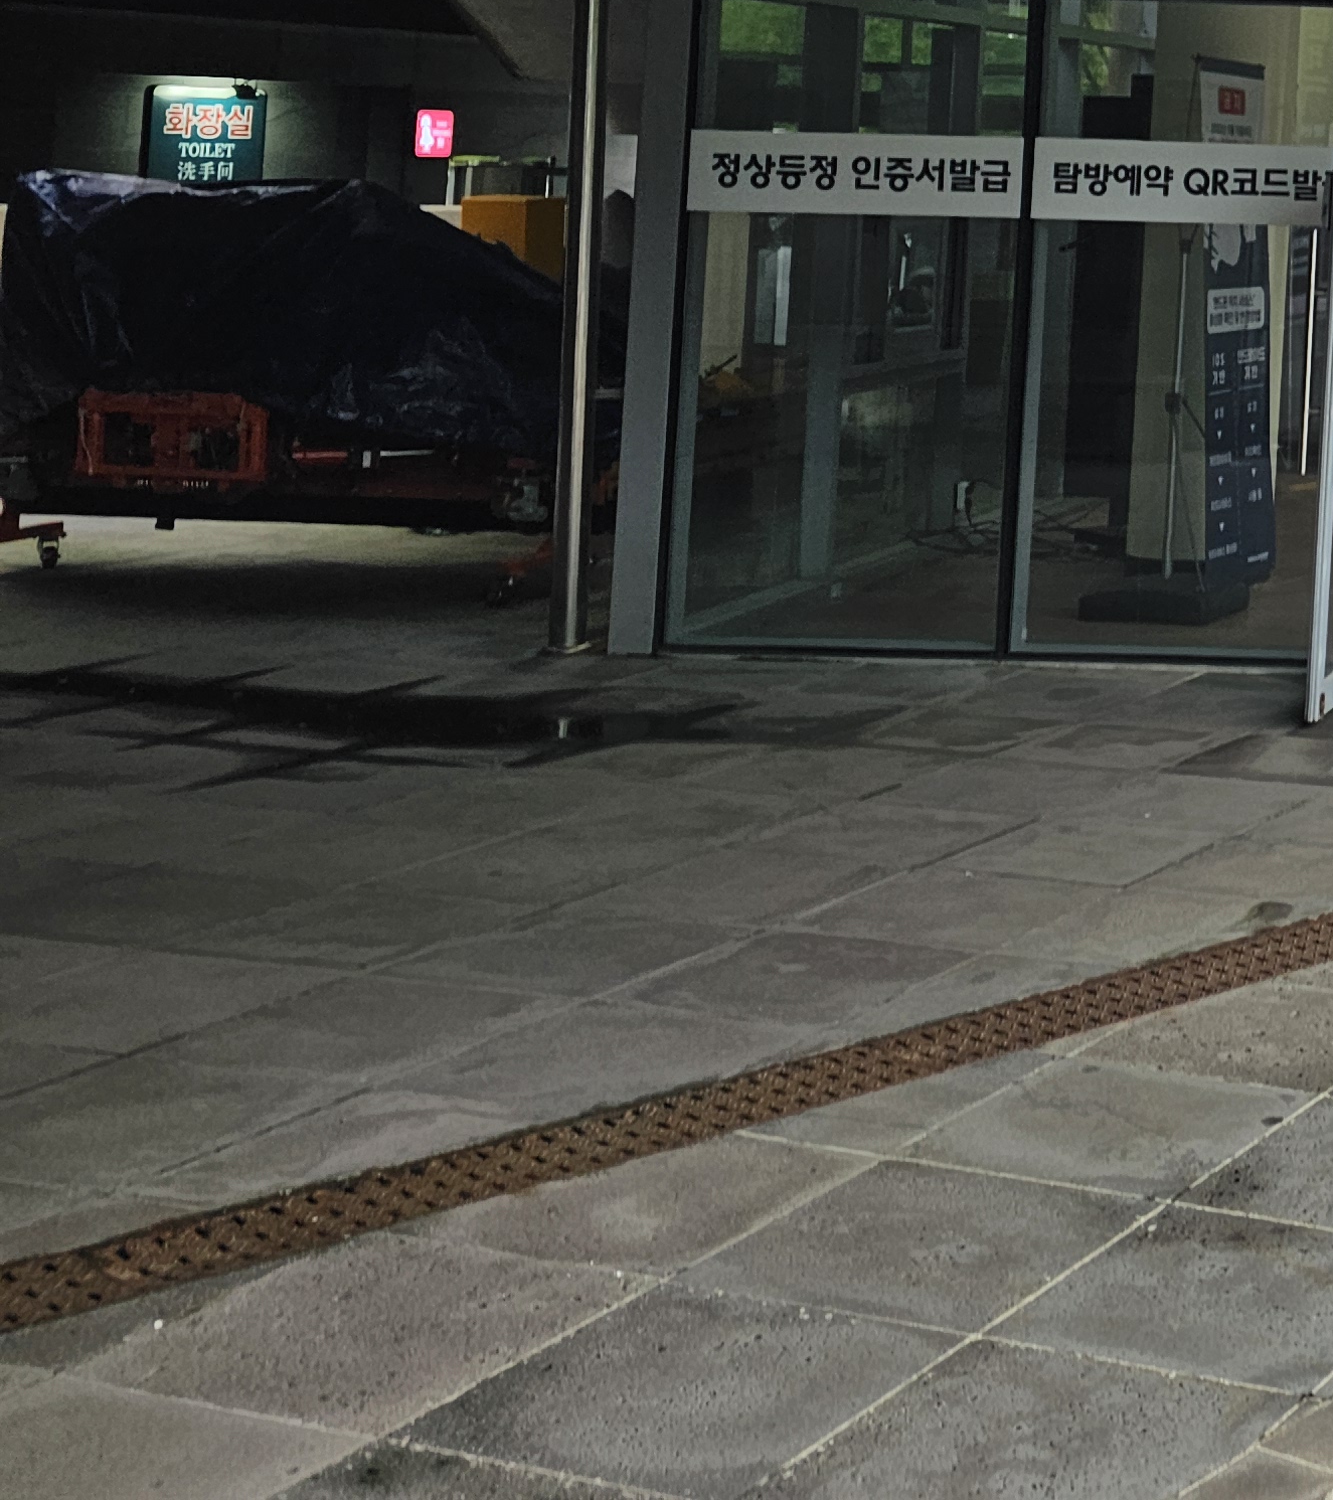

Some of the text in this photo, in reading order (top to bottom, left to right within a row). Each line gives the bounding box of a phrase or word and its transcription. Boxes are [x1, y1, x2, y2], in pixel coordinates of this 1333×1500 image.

[163, 103, 253, 139] 화장실
[178, 142, 235, 158] TOILET
[177, 161, 234, 181] 洗手间
[711, 152, 1012, 193] 정상등정 인증서발급
[1052, 162, 1173, 197] 탐방예약
